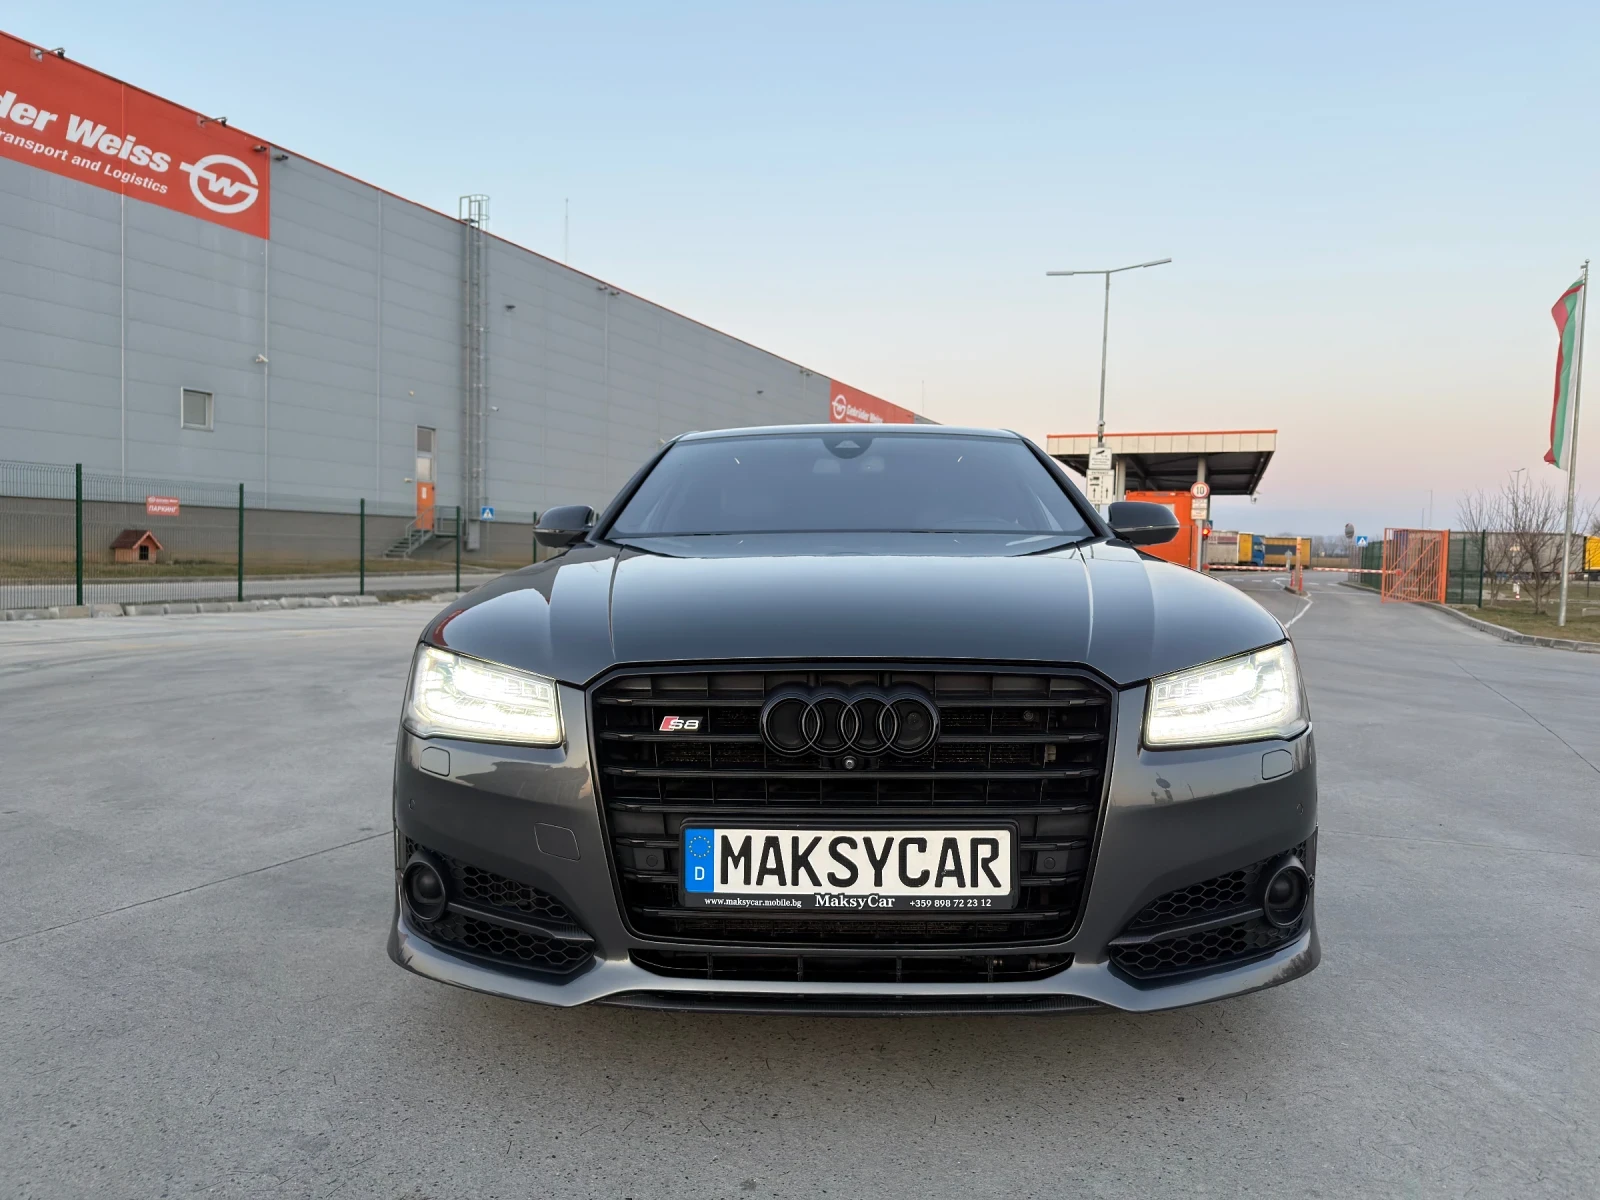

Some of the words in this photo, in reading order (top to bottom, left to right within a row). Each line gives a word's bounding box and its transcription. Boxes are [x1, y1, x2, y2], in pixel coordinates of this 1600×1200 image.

[66, 114, 171, 172] Weiss
[71, 155, 101, 172] and
[104, 164, 168, 193] Logistics
[1196, 486, 1205, 495] 10
[148, 505, 176, 513] ПАРКИНГ
[668, 719, 700, 730] S8
[720, 835, 1002, 888] MAKSYCAR
[694, 866, 705, 881] D
[704, 897, 802, 908] www.maksycar.mobile.bg
[815, 894, 895, 909] MaksyCar
[909, 899, 932, 908] +359
[934, 898, 951, 908] 898
[953, 898, 965, 907] 72
[967, 898, 979, 907] 23
[980, 898, 992, 907] 12
